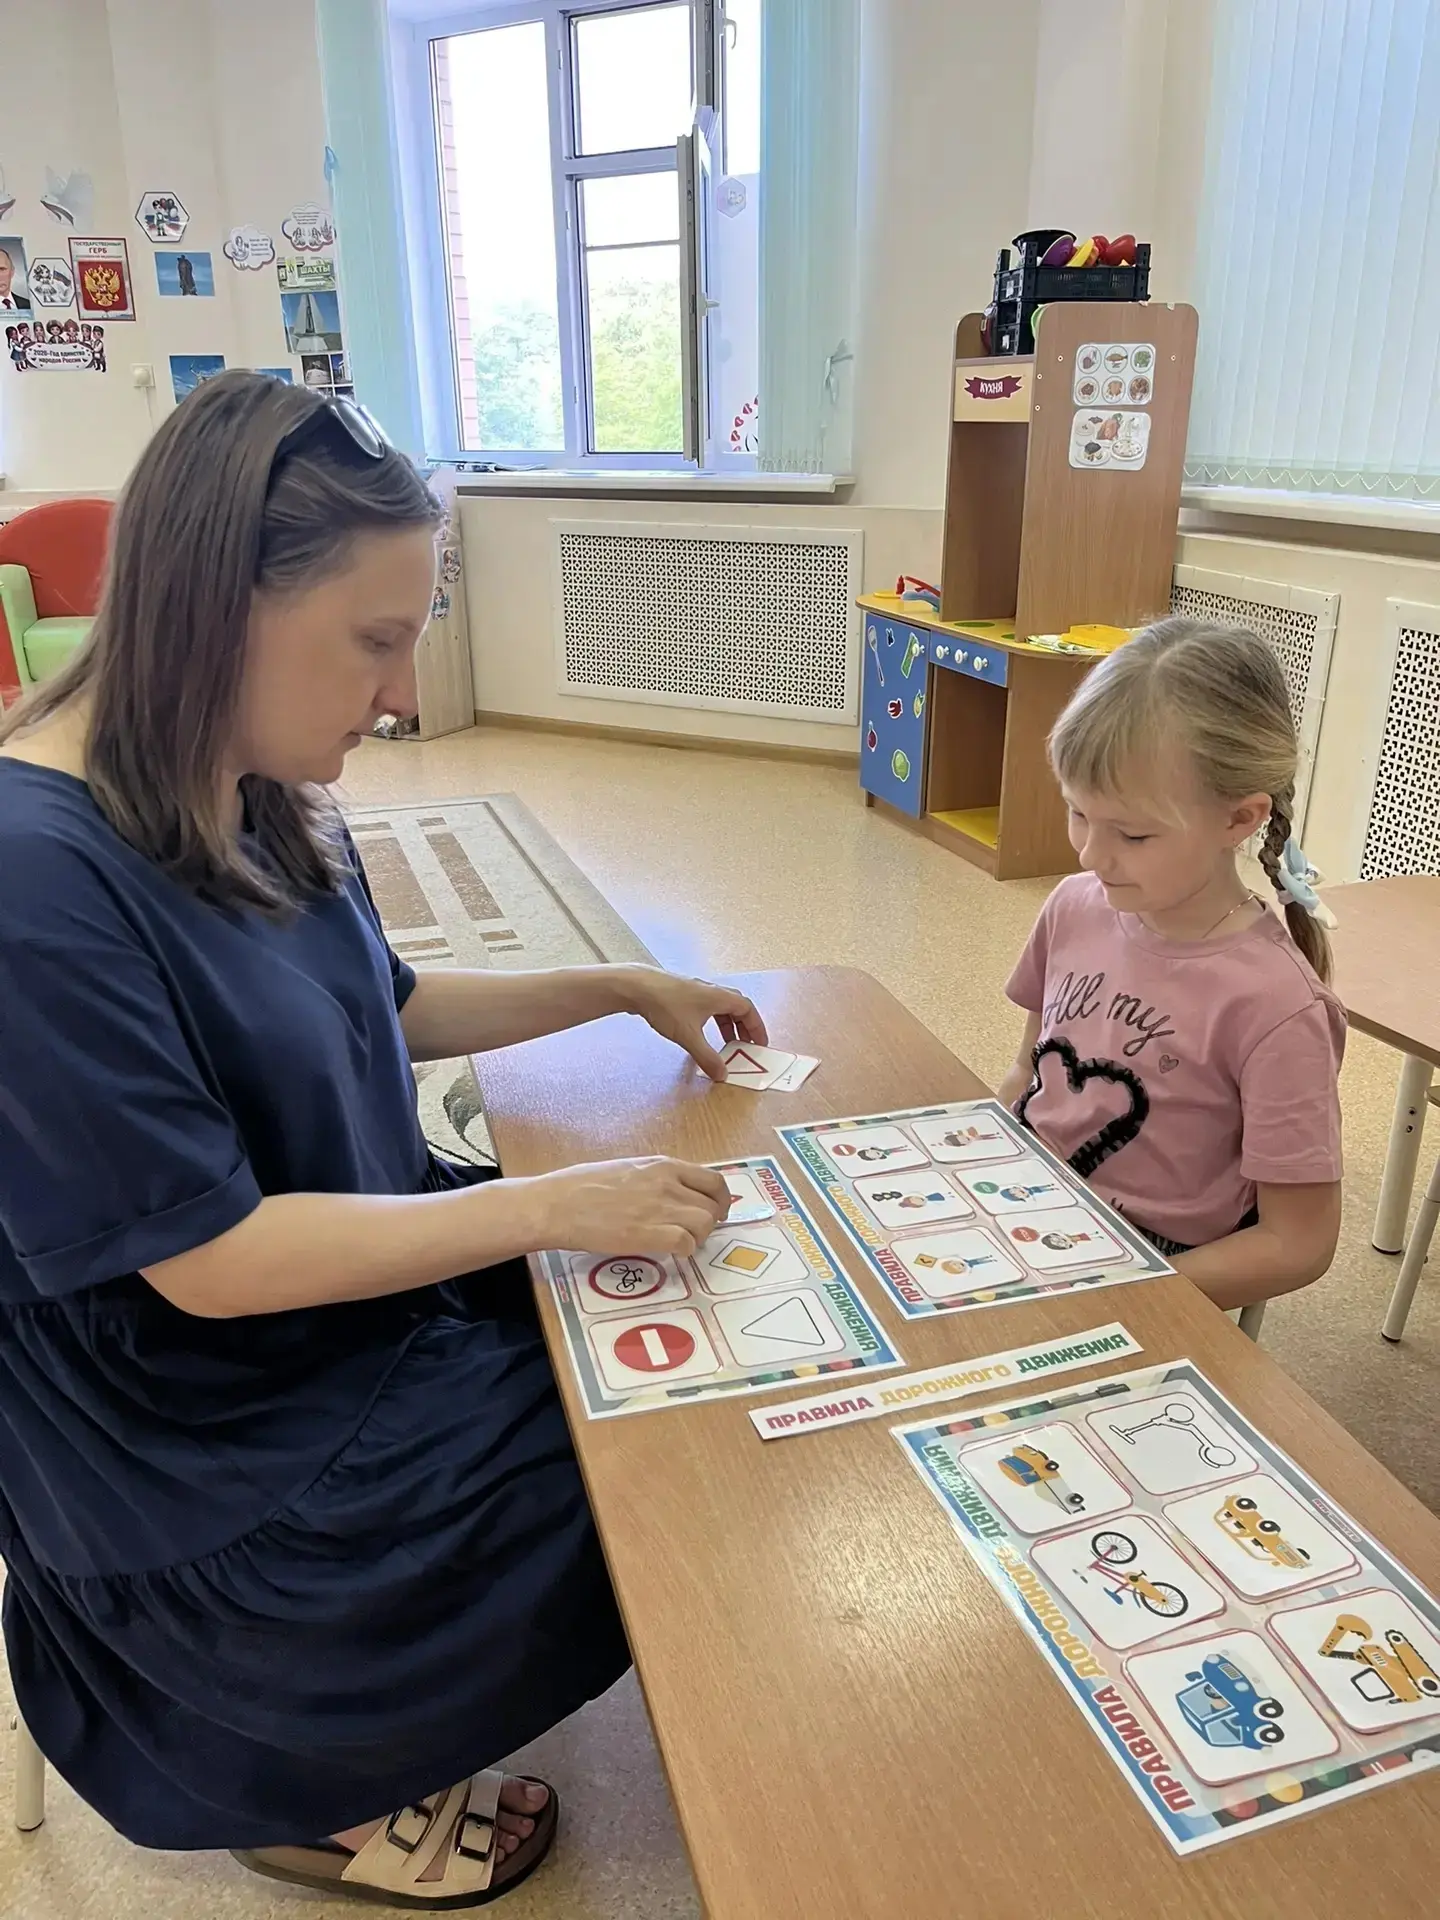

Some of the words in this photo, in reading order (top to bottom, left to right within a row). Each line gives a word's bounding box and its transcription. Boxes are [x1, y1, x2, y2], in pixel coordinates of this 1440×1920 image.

[300, 265, 331, 274] ШАХТЫ
[980, 381, 1003, 395] КУХНЯ
[1043, 971, 1105, 1026] All
[1106, 992, 1175, 1057] my
[793, 1135, 839, 1183] ДВИЖЕНИЯ
[828, 1185, 885, 1246] ДОРОЖНОГО
[756, 1168, 793, 1211] ПРАВИЛА
[782, 1213, 834, 1280] ДОРОЖНОГО
[823, 1282, 879, 1352] ДВИЖЕНИЯ
[874, 1248, 923, 1303] ПРАВИЛА
[765, 1396, 875, 1430] ПРАВИЛА
[879, 1363, 1012, 1406] ДОРОЖНОГО
[1015, 1333, 1130, 1373] ДВИЖЕНИЯ
[924, 1444, 1008, 1540] ДВИЖЕНИЯ
[993, 1545, 1107, 1678] ДОРОЖНОГО
[1092, 1684, 1197, 1812] ПРАВИЛА
